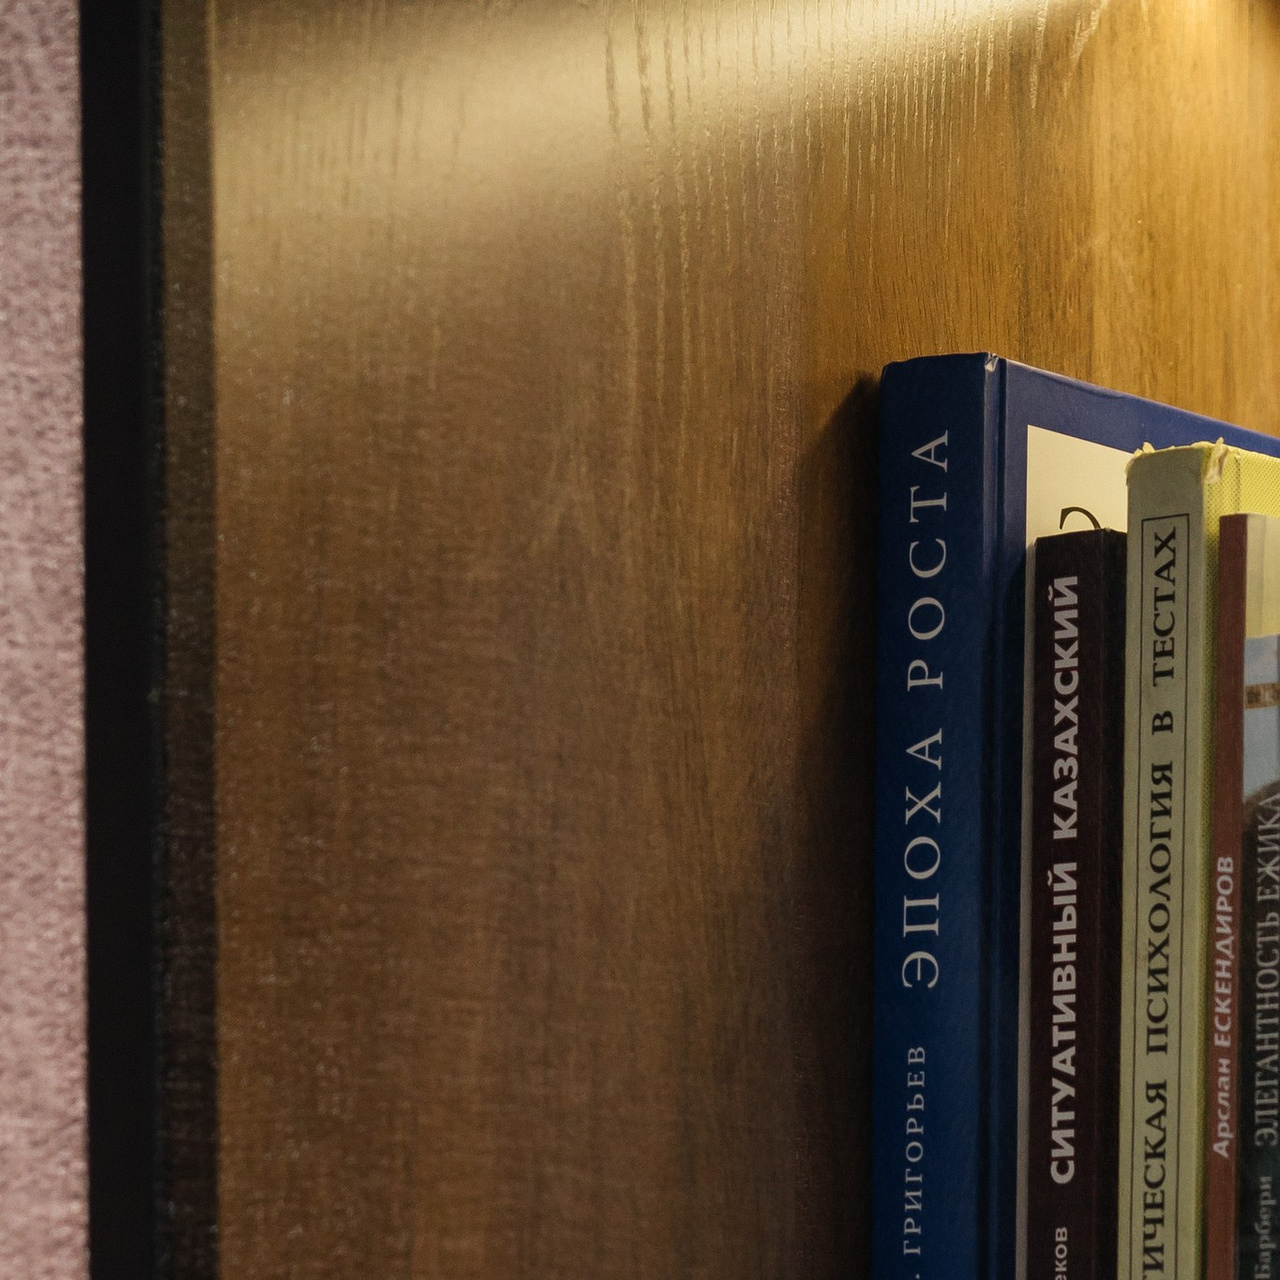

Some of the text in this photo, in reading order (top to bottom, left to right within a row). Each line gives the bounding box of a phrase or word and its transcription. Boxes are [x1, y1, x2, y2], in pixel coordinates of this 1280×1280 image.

[901, 429, 948, 989] ЭПОХА РОСТА
[1152, 526, 1177, 687] ТЕСТАХ
[1152, 709, 1174, 736] В
[1047, 575, 1079, 1184] СИТУАТИВНЫЙ КАЗАХСКИЙ
[1146, 760, 1173, 1055] ПСИХОЛОГИЯ
[1212, 855, 1234, 1160] Арслан ЕСКЕНДИРОВ
[903, 1046, 926, 1256] ГРИГОРЬЕВ
[1254, 910, 1280, 1148] ЭЛЕГАНТНОСТЬ
